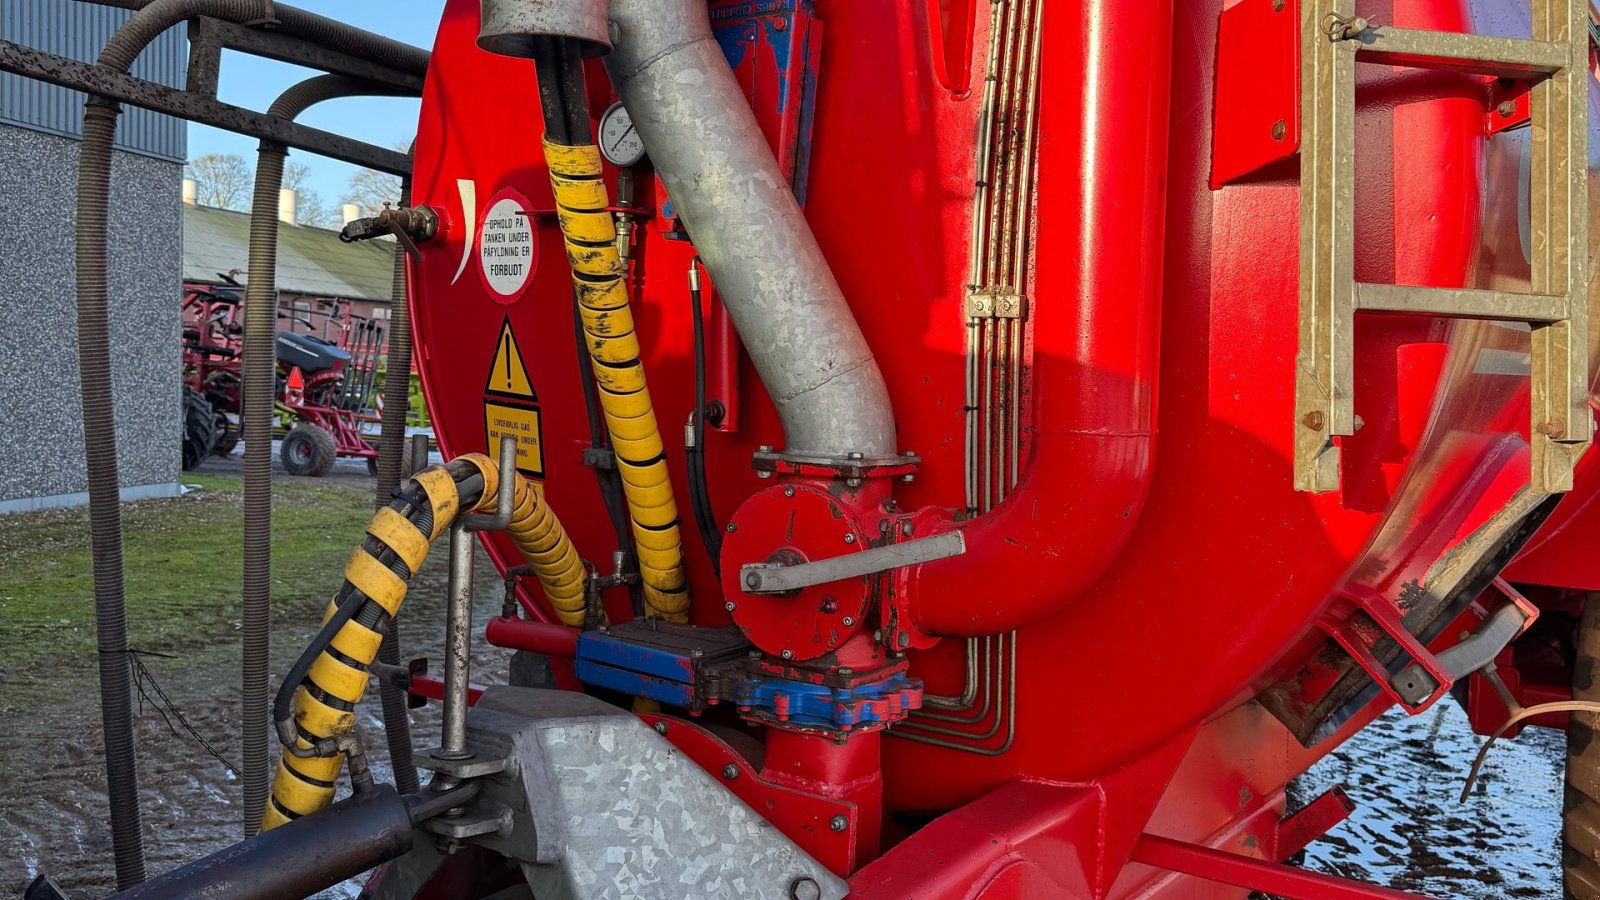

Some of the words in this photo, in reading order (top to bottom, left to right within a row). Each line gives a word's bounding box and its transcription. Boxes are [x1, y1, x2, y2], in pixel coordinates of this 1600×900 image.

[490, 219, 512, 229] OPHOLD
[516, 216, 523, 228] PÅ
[484, 233, 506, 243] TANKEN
[508, 232, 529, 243] UNDER
[483, 245, 519, 257] PÅFYLDNING
[521, 246, 530, 257] ER
[490, 264, 523, 276] FORBUDT
[521, 423, 530, 431] GAS
[521, 436, 537, 445] UNDER
